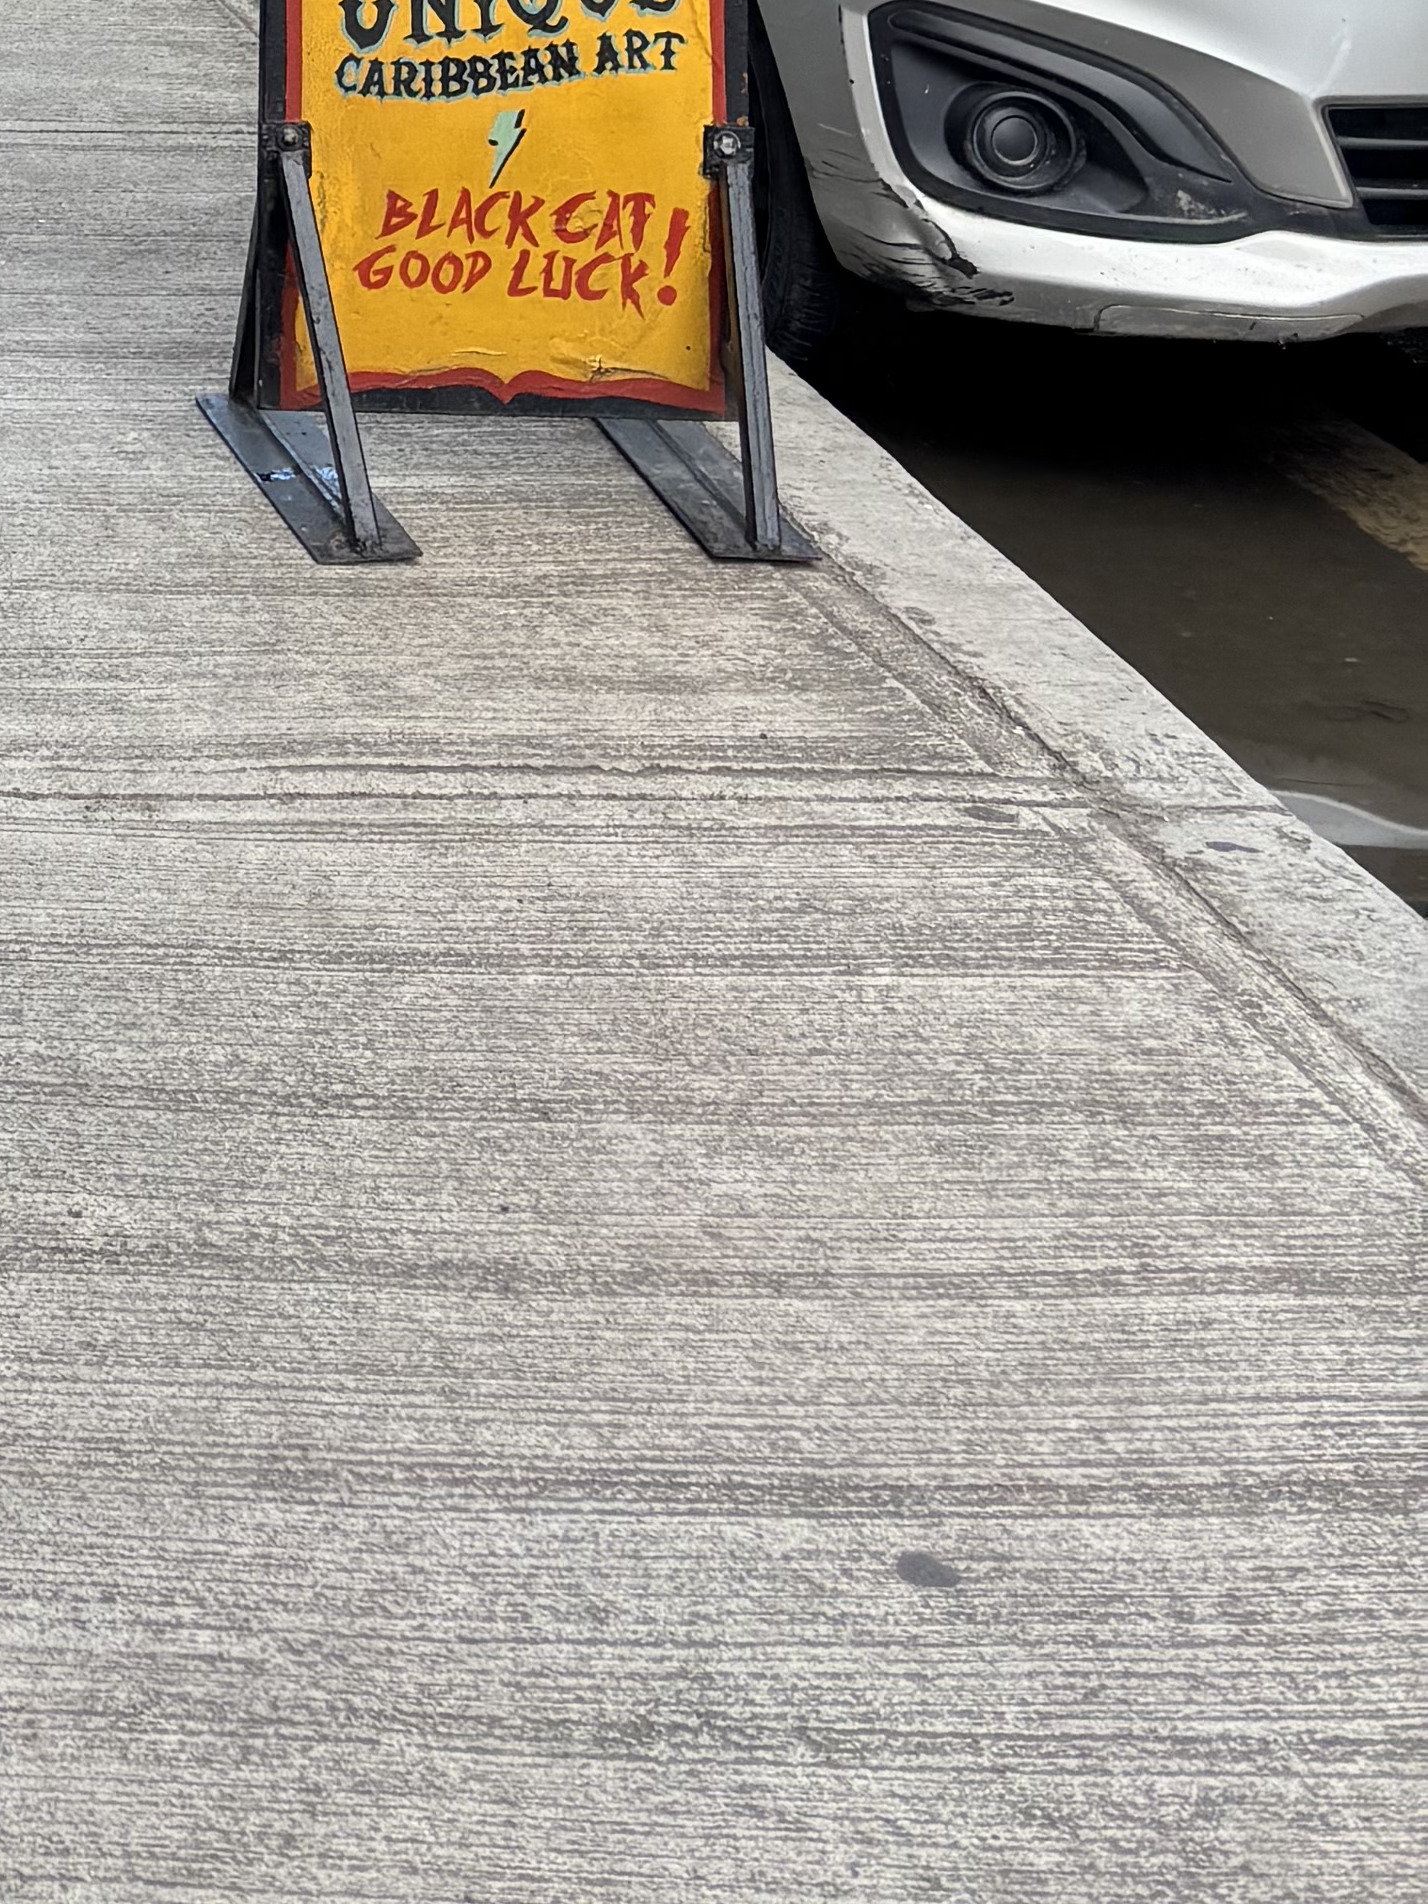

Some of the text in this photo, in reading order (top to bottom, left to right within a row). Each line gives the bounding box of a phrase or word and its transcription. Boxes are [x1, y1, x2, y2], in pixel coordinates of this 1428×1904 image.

[333, 28, 687, 103] CARIBBEAN ART
[374, 186, 656, 253] BLACK CAT
[352, 244, 493, 295] GOOD
